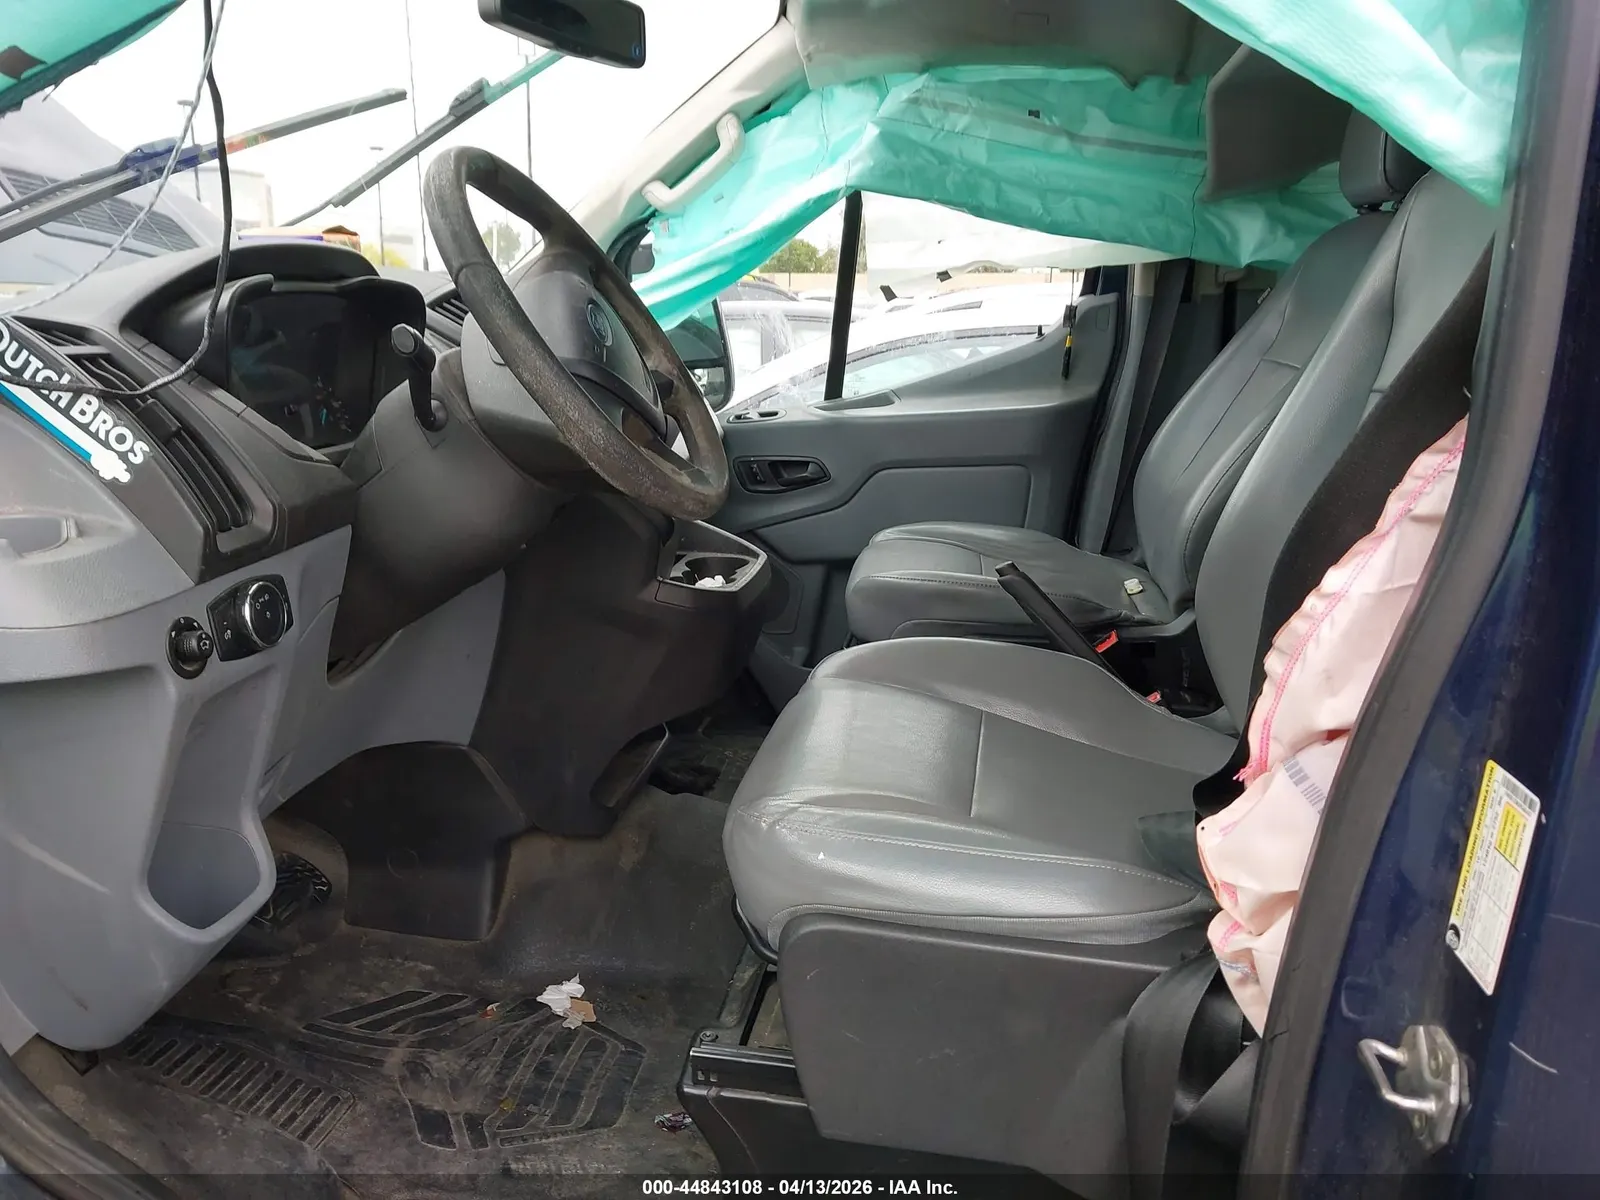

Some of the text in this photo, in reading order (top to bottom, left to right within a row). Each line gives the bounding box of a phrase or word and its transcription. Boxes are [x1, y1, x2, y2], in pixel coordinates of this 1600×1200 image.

[69, 393, 150, 465] BROS
[1455, 897, 1463, 917] TIRE
[1466, 833, 1479, 873] LOADING
[1476, 766, 1495, 831] INFORMATION
